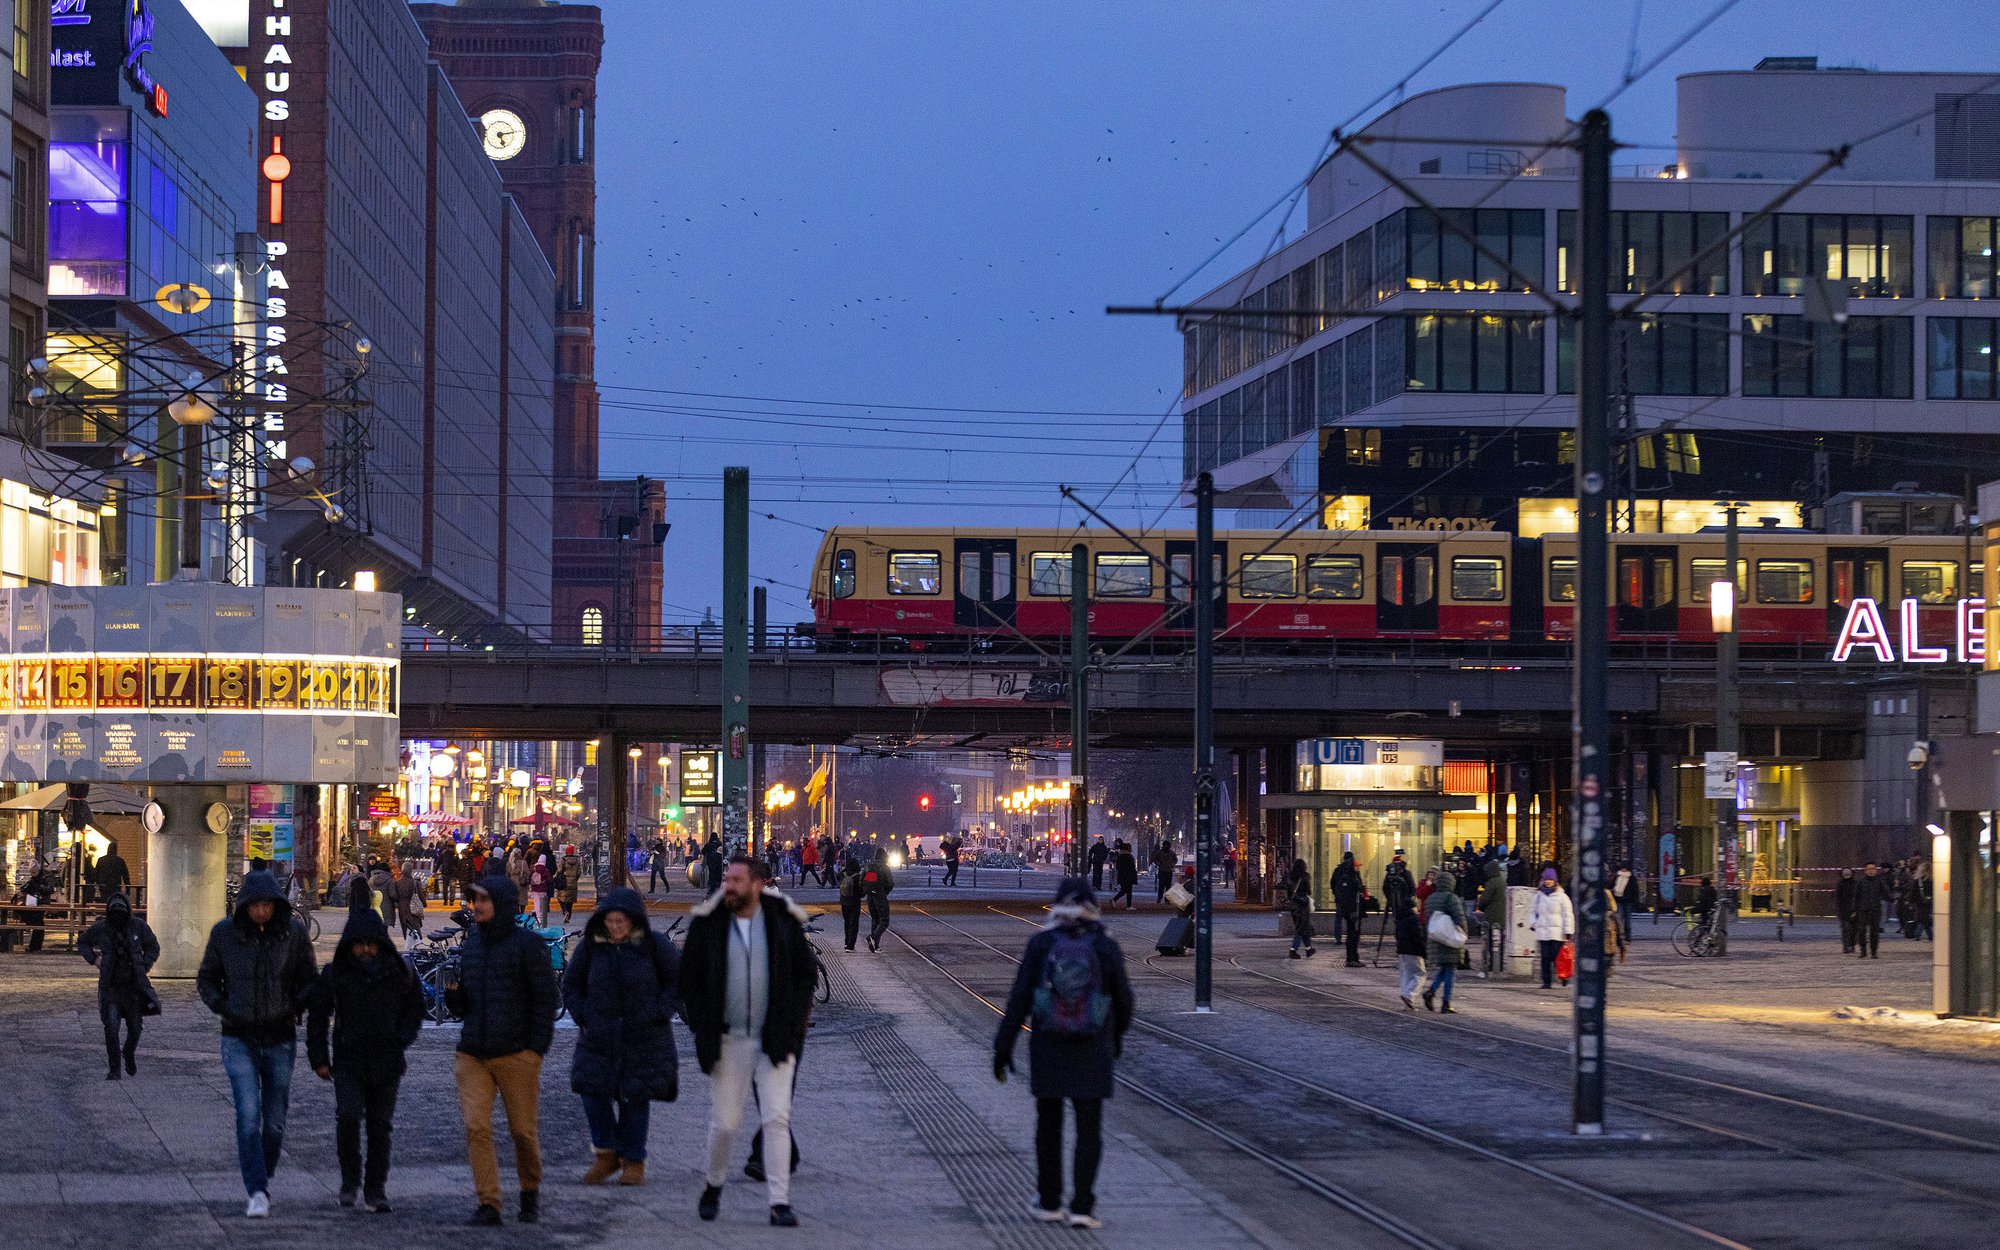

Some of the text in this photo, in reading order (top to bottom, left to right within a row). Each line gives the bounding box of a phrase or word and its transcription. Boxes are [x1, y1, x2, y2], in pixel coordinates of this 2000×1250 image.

[264, 241, 289, 460] PASSAGEN
[1832, 598, 1986, 663] ALE
[19, 666, 46, 698] 14
[55, 666, 88, 698] 15
[99, 665, 137, 698] 16
[151, 666, 192, 697] 17
[206, 666, 244, 699] 18
[256, 667, 294, 699] 19
[301, 668, 338, 701] 20
[342, 669, 366, 701] 21
[1318, 740, 1337, 763] U
[1383, 754, 1397, 763] U5
